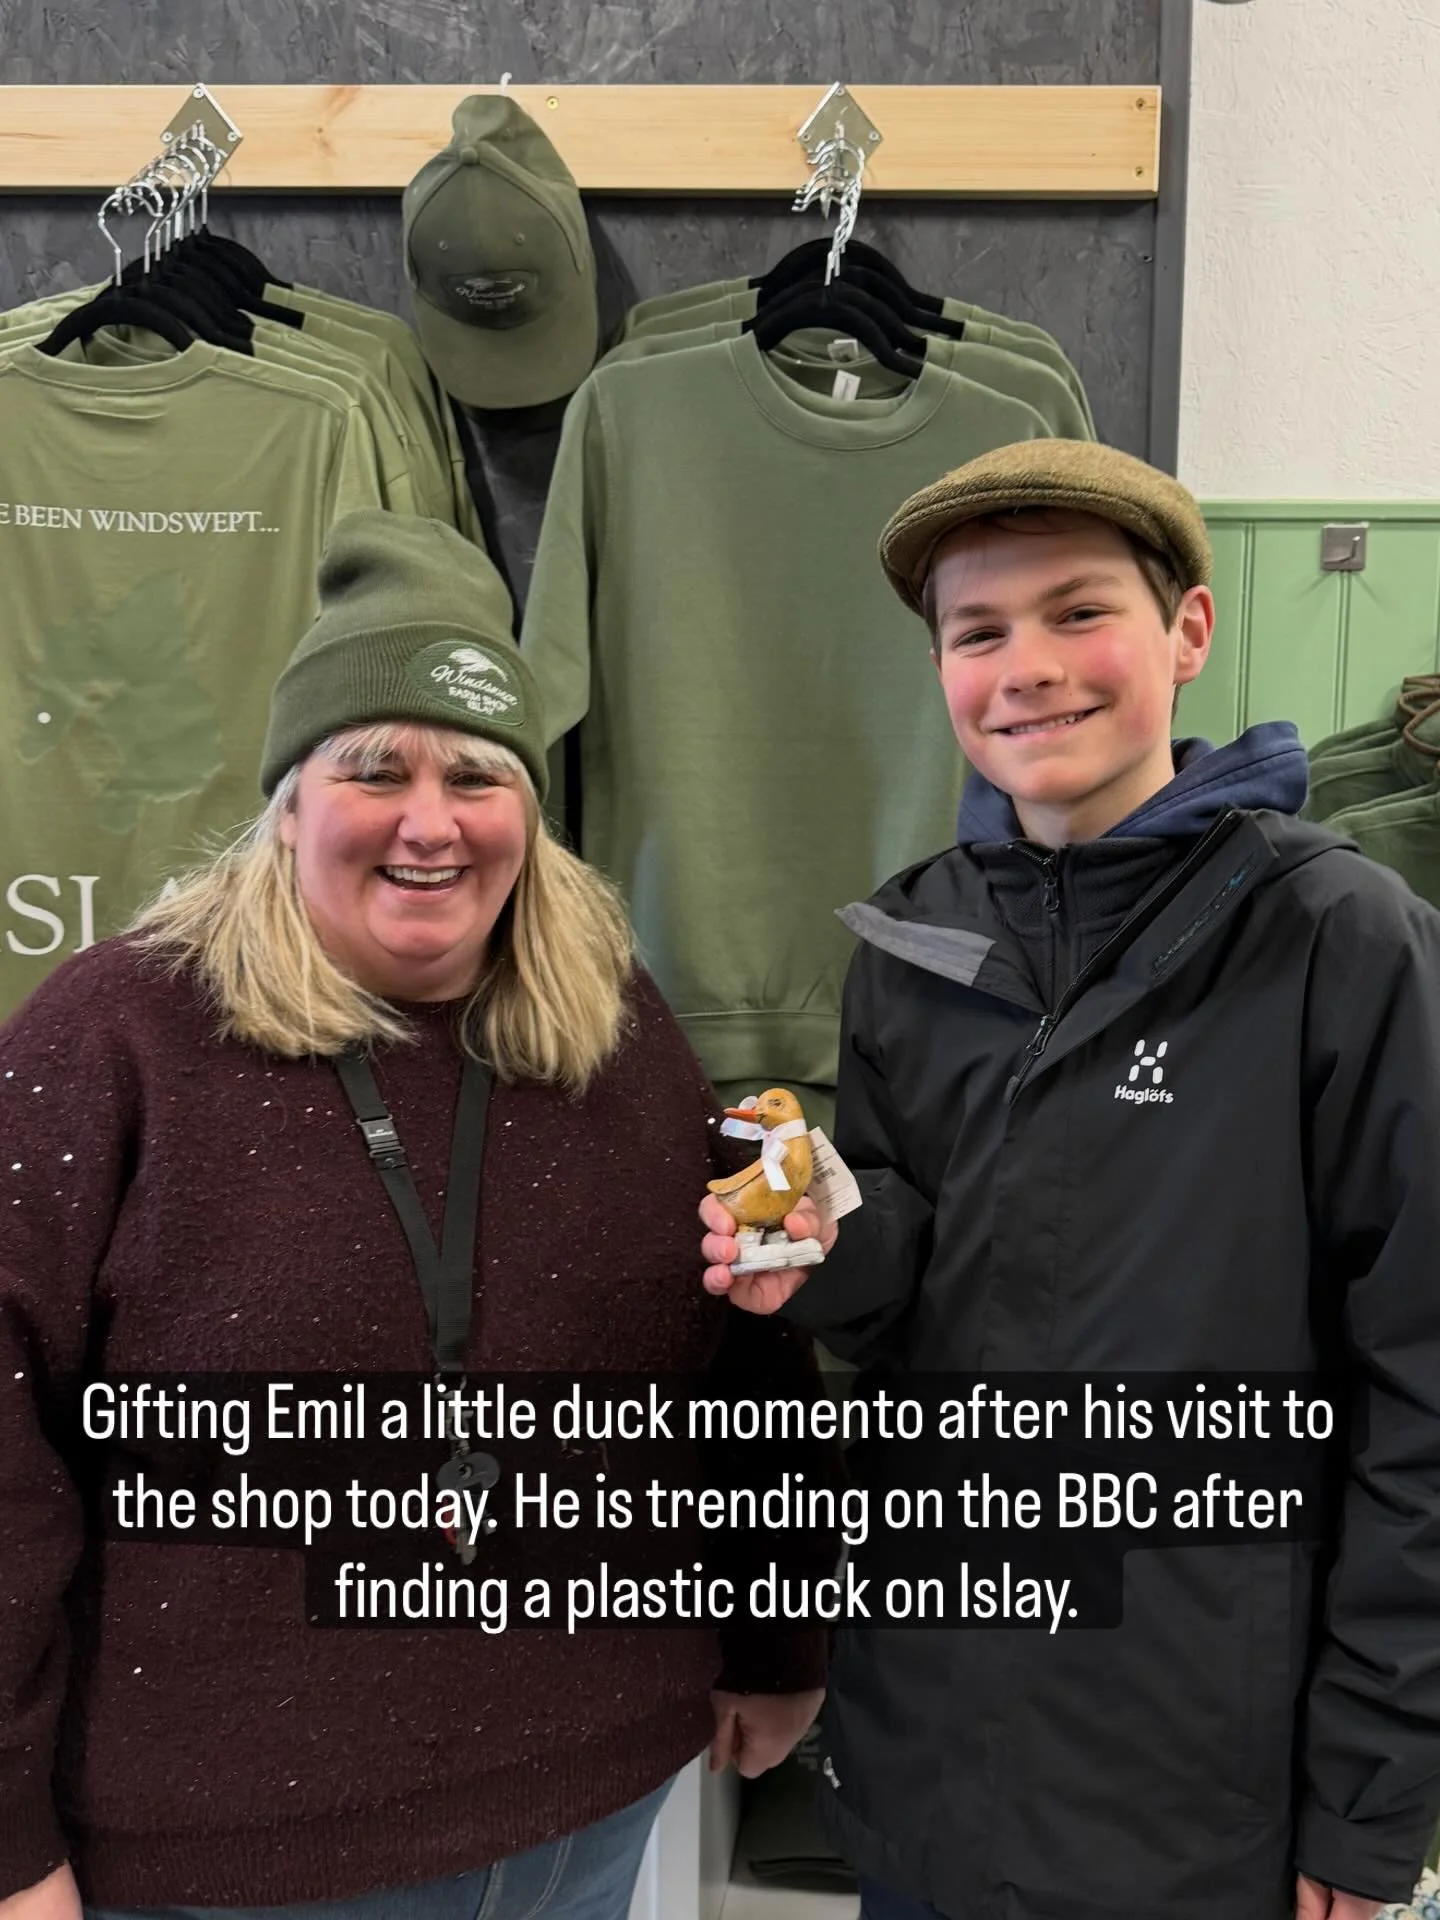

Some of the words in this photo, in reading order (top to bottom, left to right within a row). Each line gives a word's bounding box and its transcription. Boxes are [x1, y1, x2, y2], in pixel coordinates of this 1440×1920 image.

[15, 504, 83, 529] BEEN
[88, 509, 280, 535] WINDSWEPT...
[1114, 1084, 1174, 1105] Haglöfs
